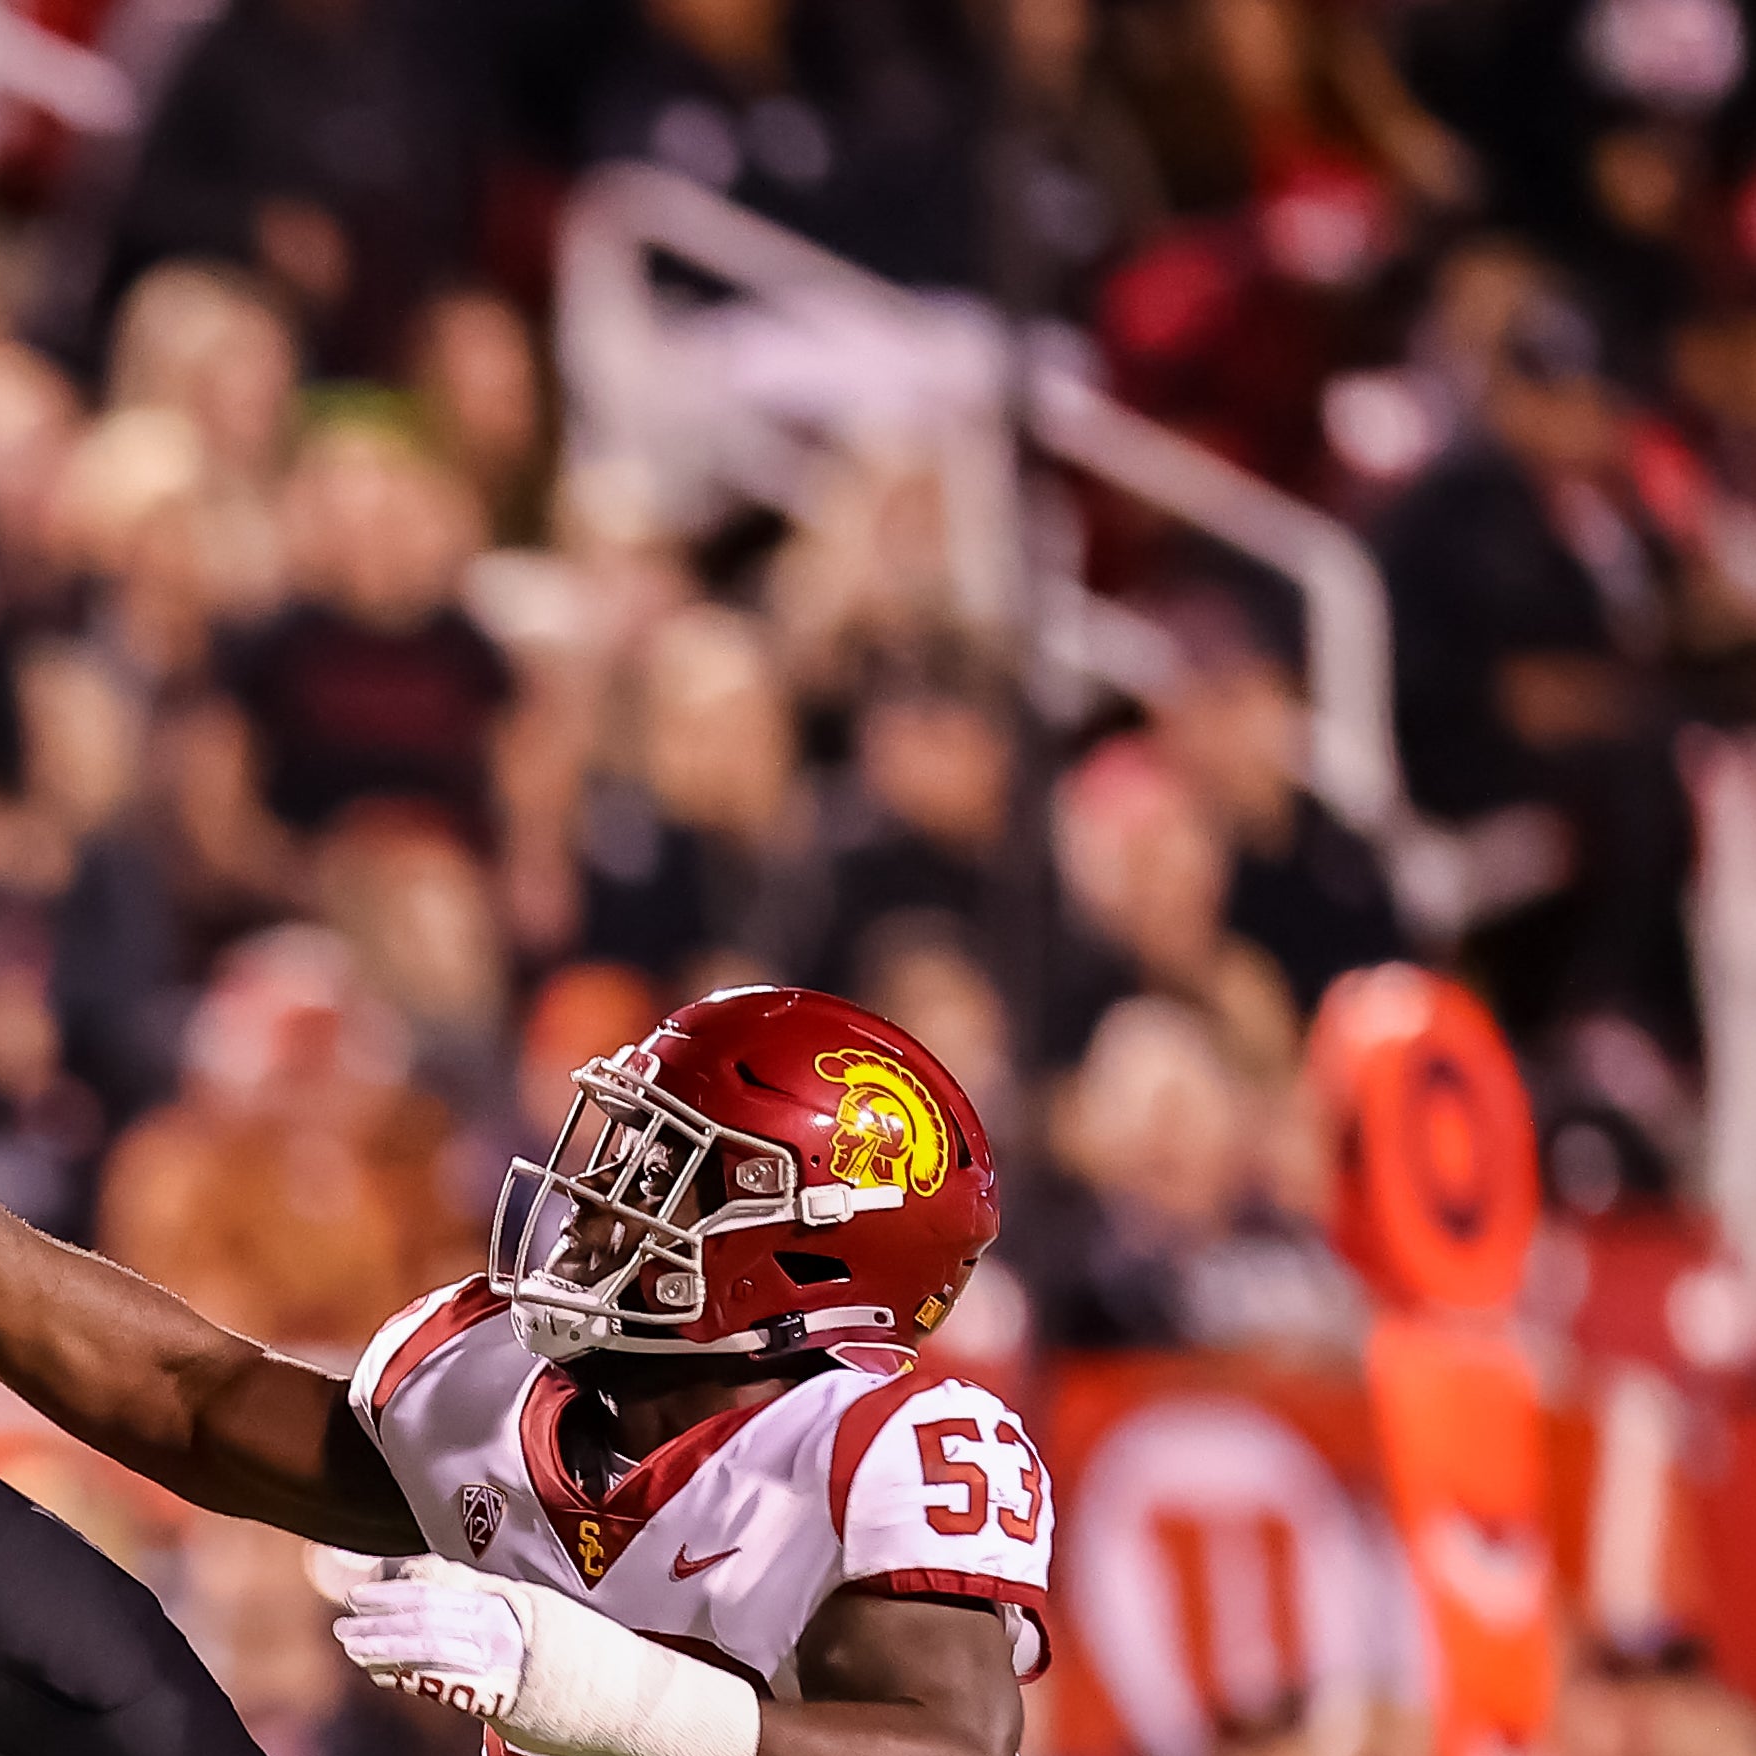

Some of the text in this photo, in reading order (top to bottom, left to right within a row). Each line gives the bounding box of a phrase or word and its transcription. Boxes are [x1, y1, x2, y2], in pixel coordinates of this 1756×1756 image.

[912, 1417, 1044, 1546] 53
[462, 1485, 504, 1532] PAC
[468, 1515, 487, 1545] 12
[577, 1519, 606, 1578] SC
